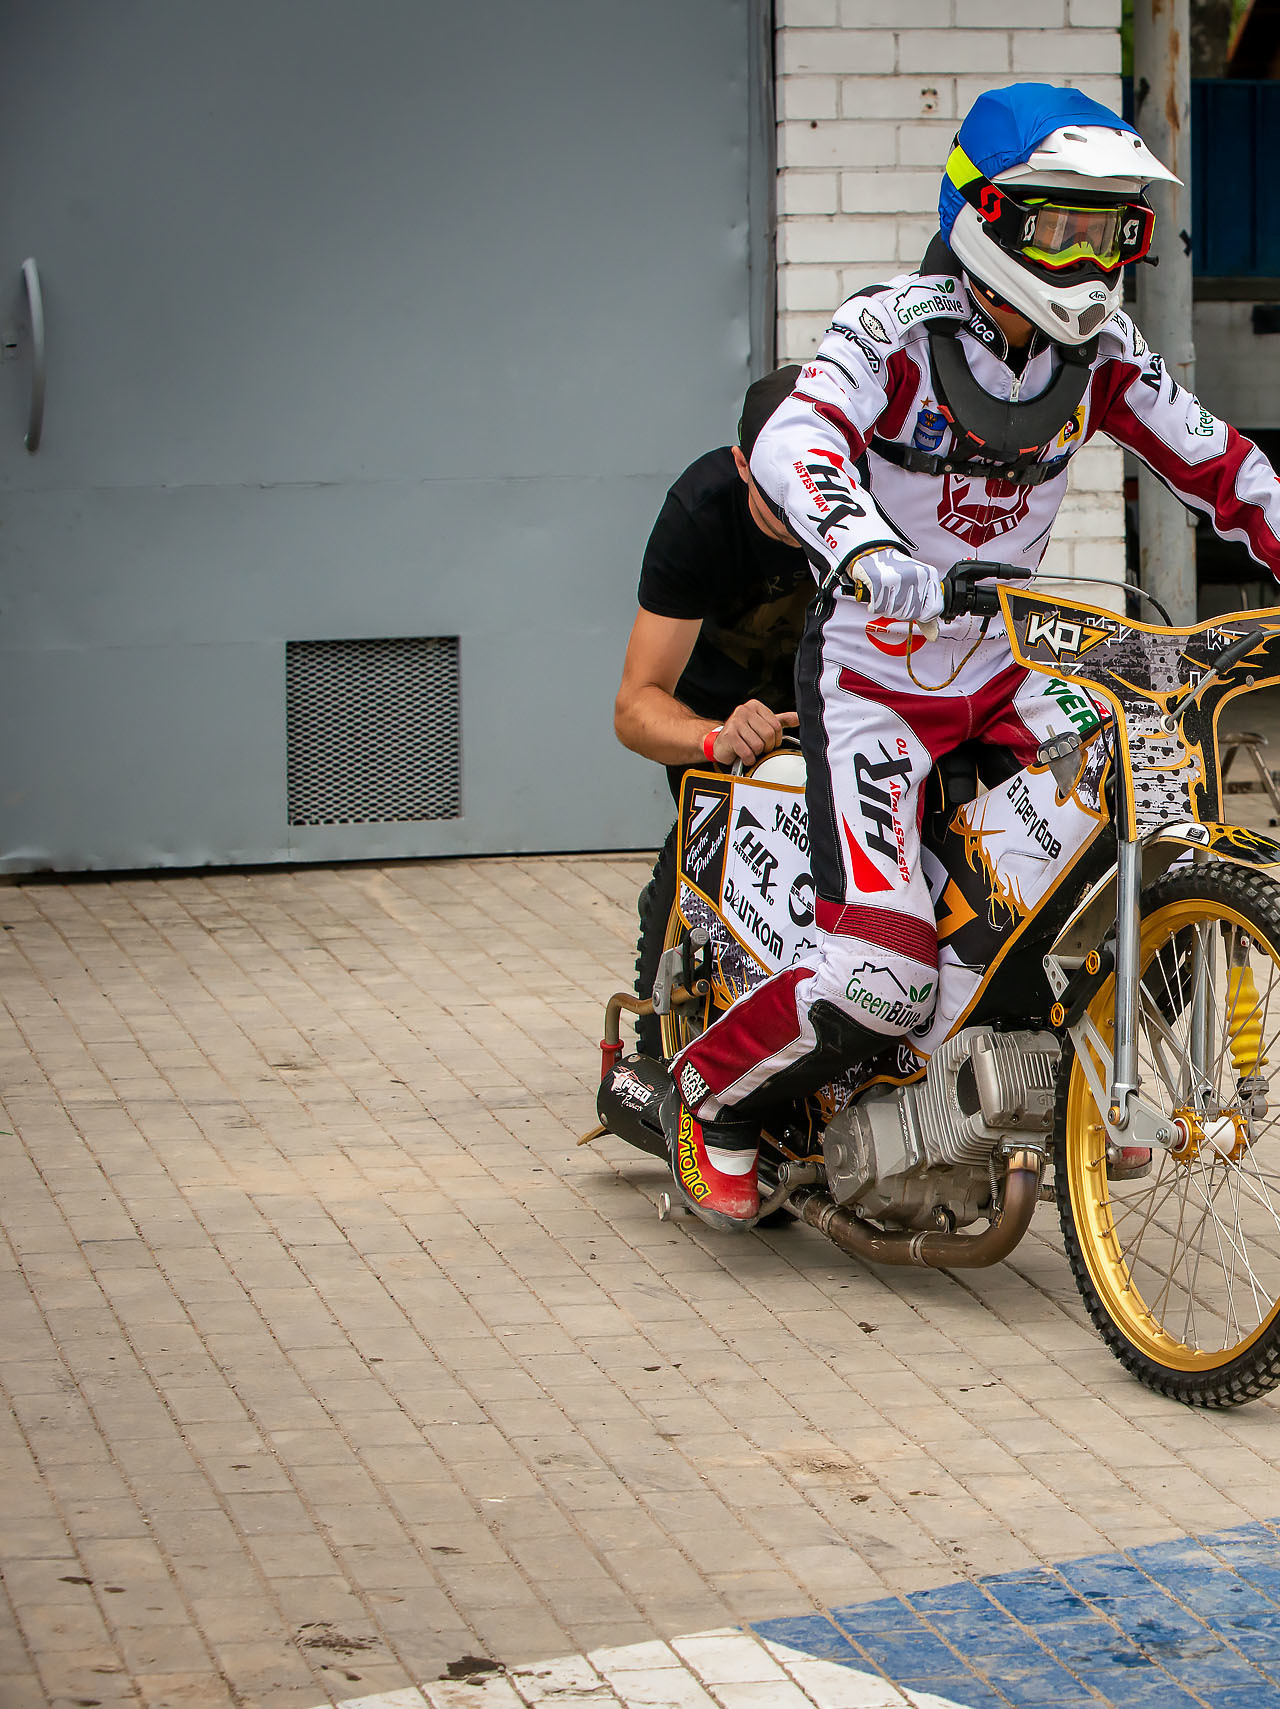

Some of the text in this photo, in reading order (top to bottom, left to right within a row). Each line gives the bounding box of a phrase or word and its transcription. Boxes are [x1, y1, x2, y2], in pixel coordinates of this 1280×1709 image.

[792, 461, 838, 549] FASTEST WAY TO
[687, 790, 728, 846] 7
[889, 738, 910, 884] FASTEST WAY TO
[732, 841, 752, 867] FASTEST
[750, 860, 763, 879] WAY
